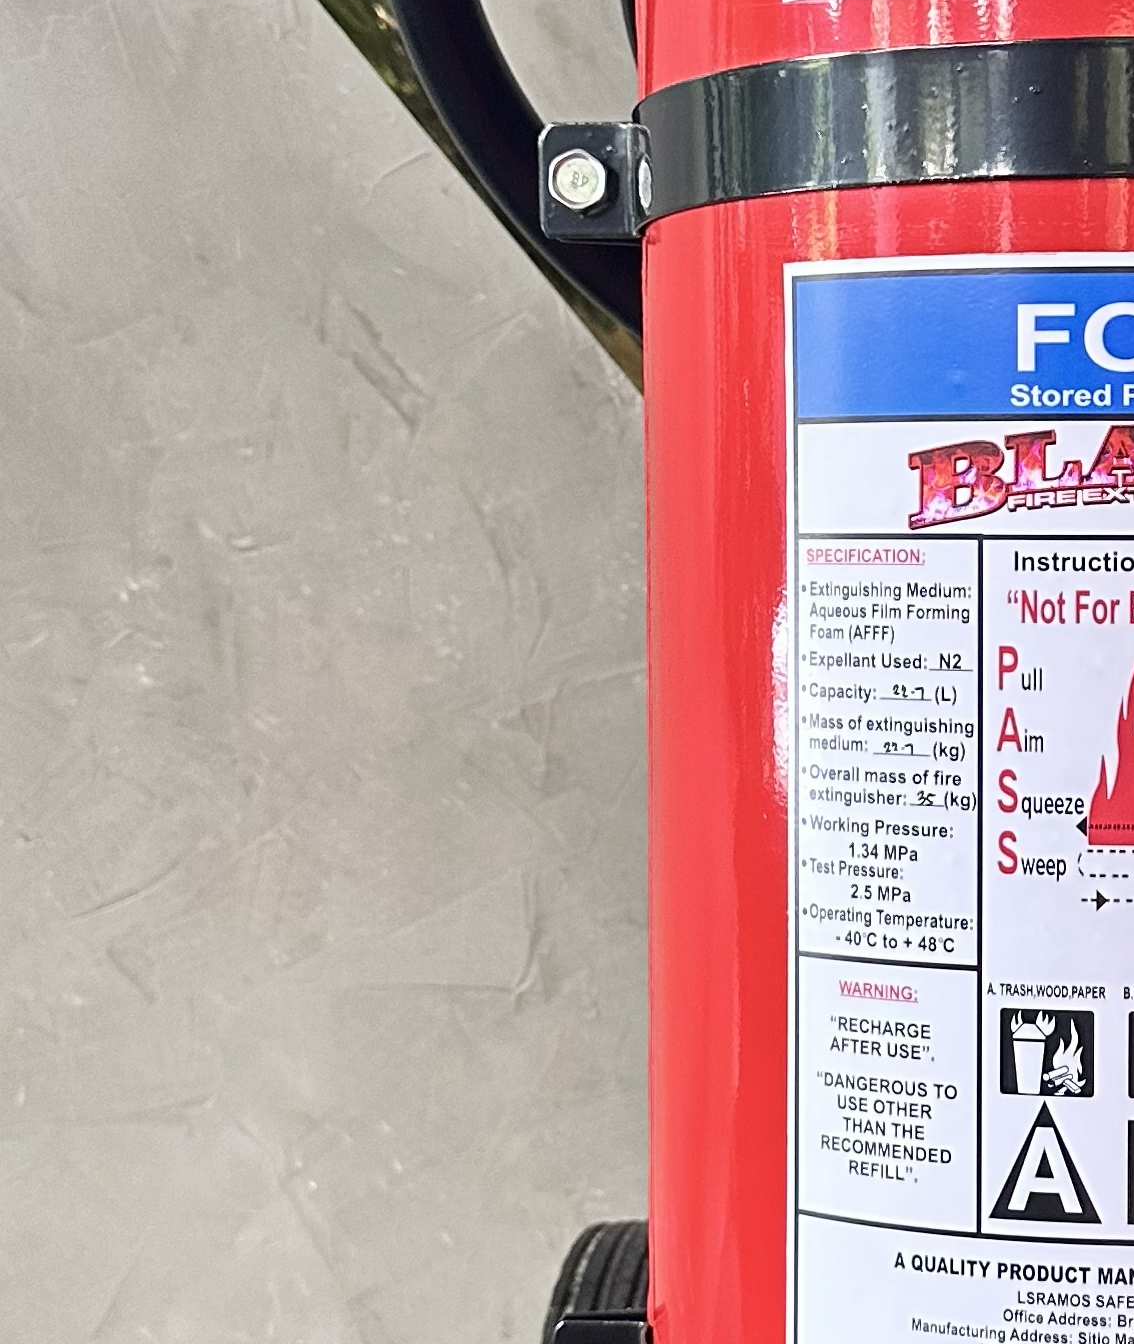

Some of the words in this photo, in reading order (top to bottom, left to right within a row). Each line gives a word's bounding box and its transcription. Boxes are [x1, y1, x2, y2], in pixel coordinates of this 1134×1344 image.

[1010, 383, 1113, 407] Stored
[1007, 489, 1076, 512] FIRE
[807, 549, 925, 565] SPECIFICATION:
[811, 582, 901, 601] Extinguishing
[907, 583, 971, 598] Medium:
[810, 603, 866, 621] Aqueous
[872, 604, 901, 619] Film
[907, 604, 969, 623] Forming
[1076, 590, 1120, 624] For
[811, 624, 844, 639] Foam
[849, 625, 894, 645] (AFFF)
[810, 652, 876, 670] Expellant
[882, 653, 927, 669] Used:
[940, 654, 962, 669] N2
[810, 683, 876, 703] Capacity:
[935, 686, 956, 705] (L)
[810, 765, 859, 781] Overall
[865, 771, 906, 783] mass
[913, 770, 929, 785] of
[934, 771, 961, 786] fire
[810, 788, 906, 806] extinguisher:
[917, 790, 936, 806] 35
[944, 791, 976, 811] (kg)
[811, 816, 869, 837] Working
[875, 820, 953, 838] Pressure:
[849, 842, 878, 859] 1.34
[885, 845, 917, 861] MPa
[810, 858, 834, 875] Test
[839, 861, 903, 879] Pressure:
[851, 884, 872, 899] 2.5
[878, 886, 910, 902] MPa
[810, 903, 871, 927] Operating
[876, 909, 973, 930] Temperature:
[839, 980, 918, 1003] WARNING:
[1000, 983, 1105, 999] TRASH,WOOD,PAPER
[830, 1037, 881, 1056] AFTER
[934, 1084, 957, 1099] TO
[838, 1094, 867, 1112] USE
[874, 1100, 931, 1119] OTHER
[843, 1117, 885, 1136] THAN
[891, 1123, 924, 1140] THE
[821, 1135, 952, 1164] RECOMMENDED
[1007, 1126, 1083, 1214] A
[895, 1252, 905, 1269] A
[912, 1255, 990, 1277] QUALITY
[998, 1263, 1090, 1284] PRODUCT
[1018, 1291, 1090, 1307] LSRAMOS
[1003, 1309, 1043, 1324] Office
[1048, 1312, 1111, 1326] Address:
[912, 1318, 1005, 1343] Manufacturing
[1010, 1328, 1072, 1344] Address:
[1079, 1332, 1109, 1344] Sitio
